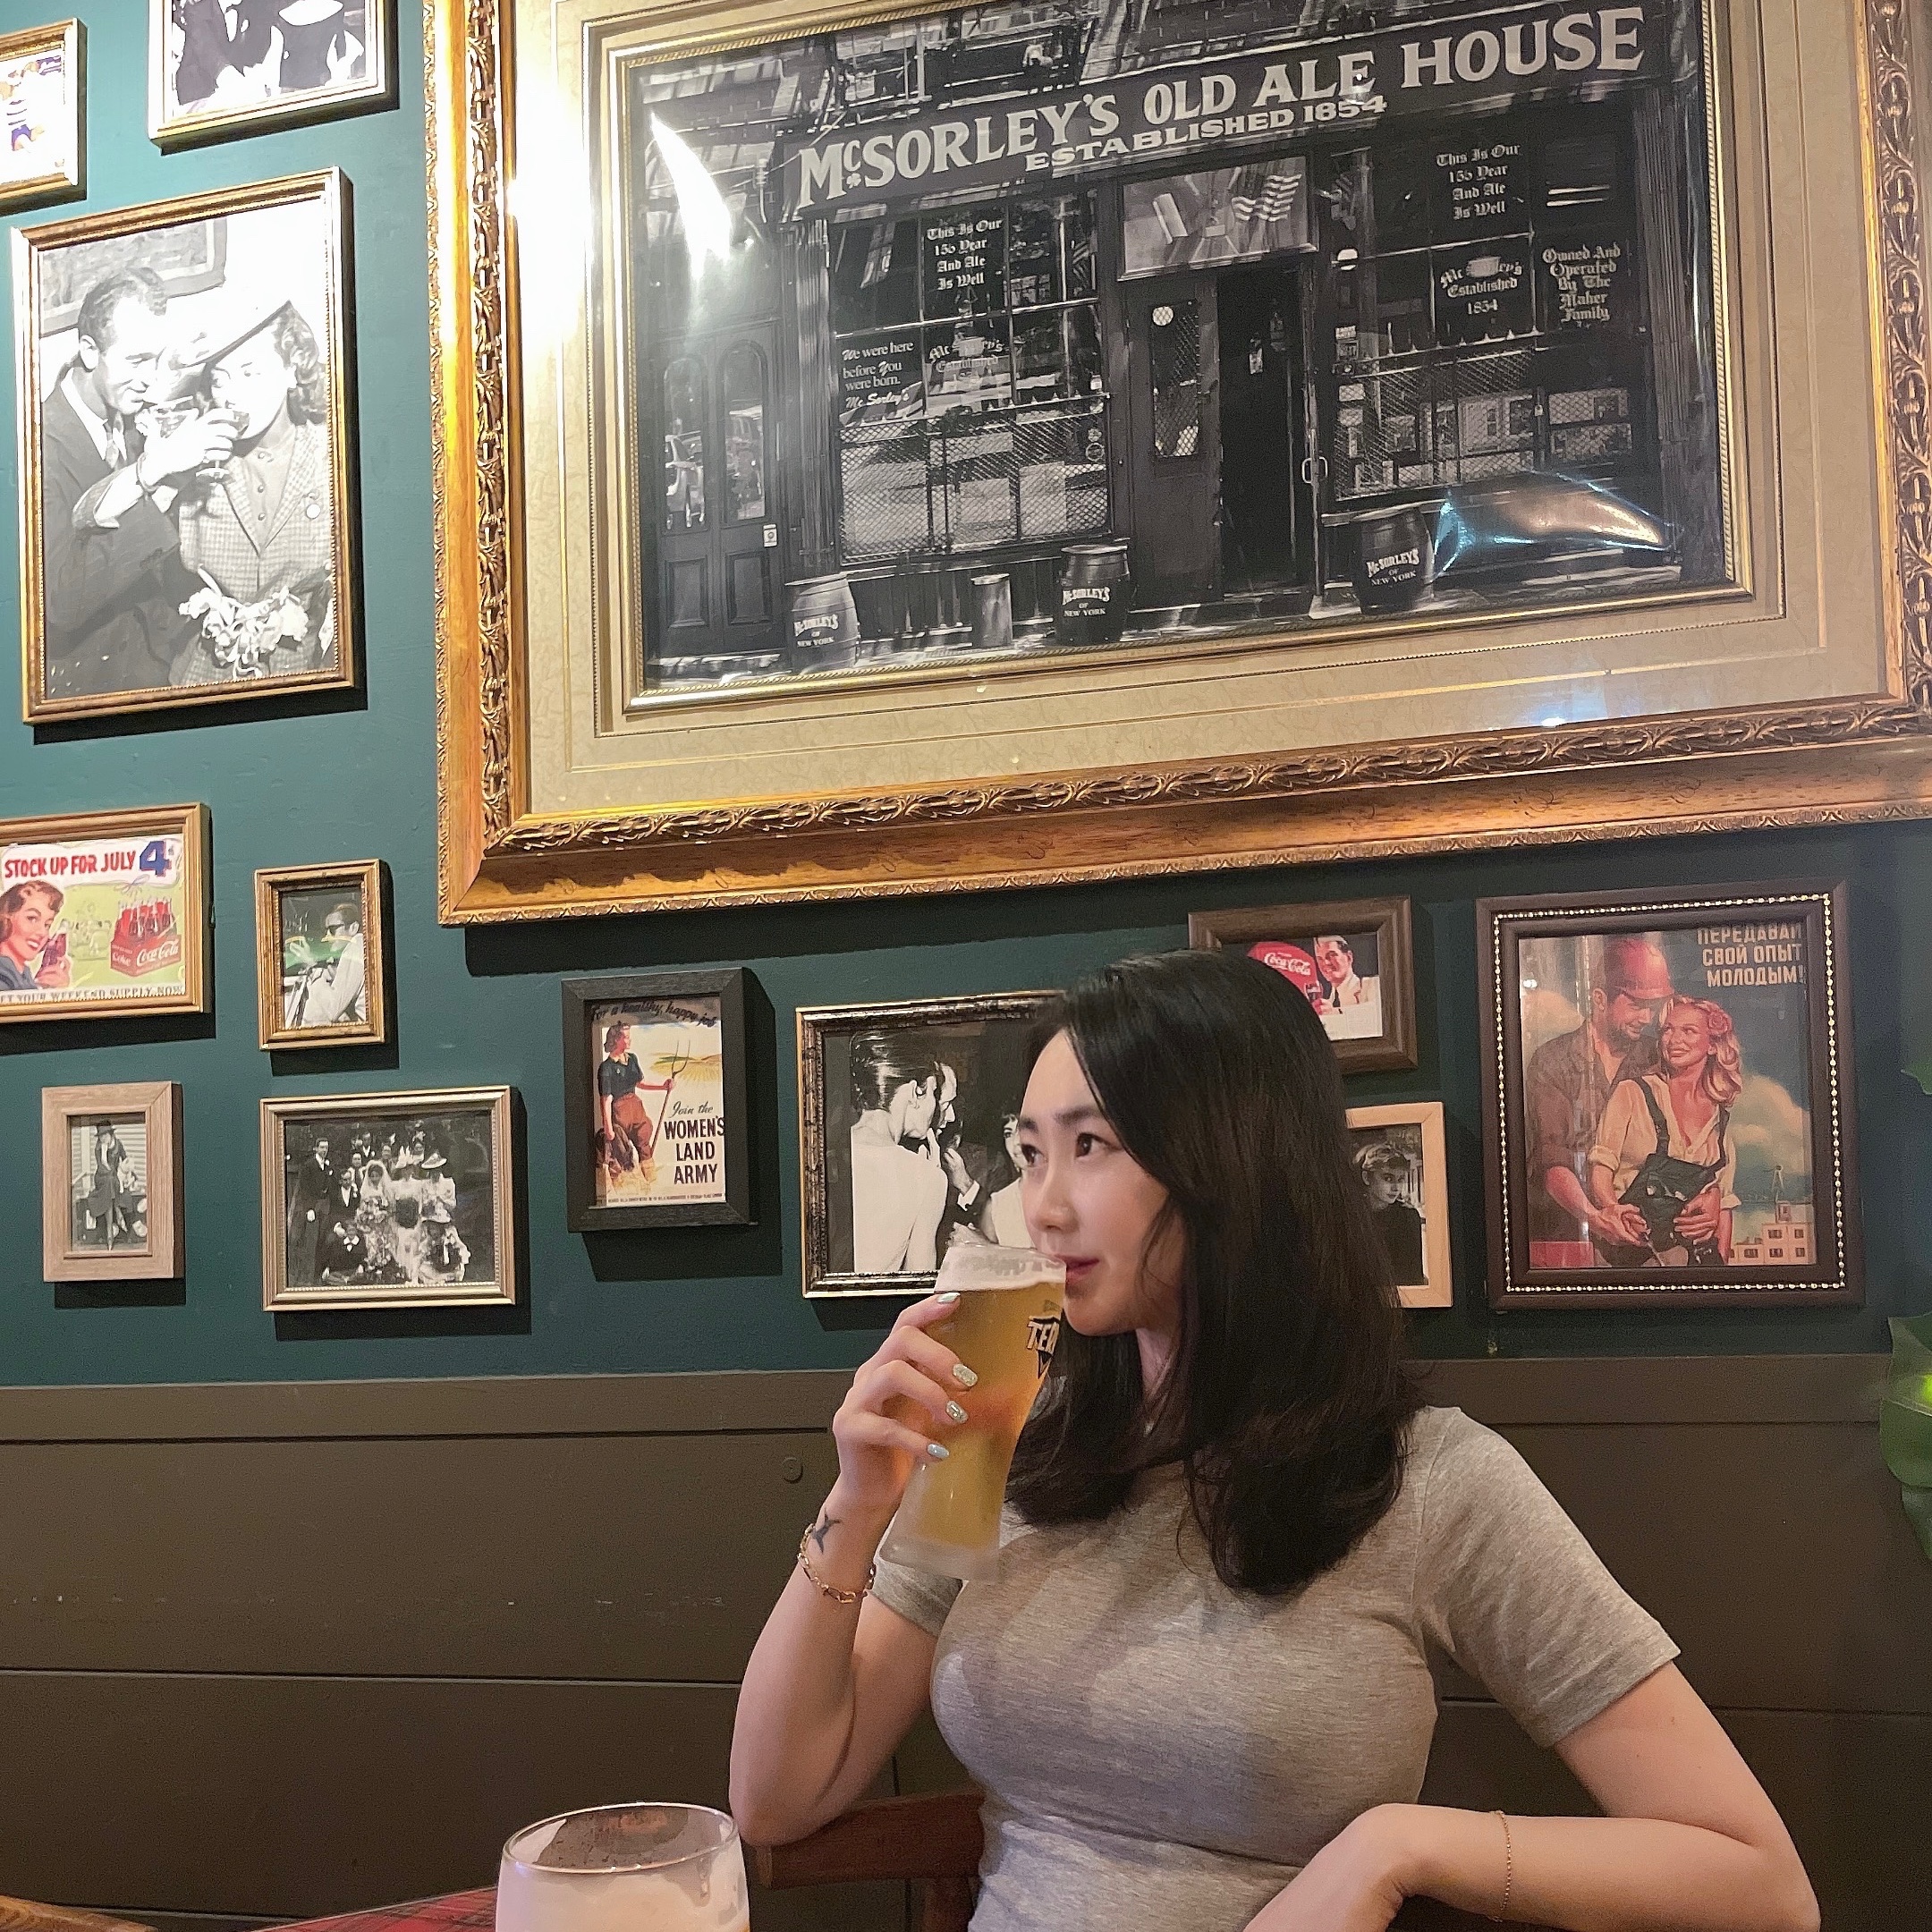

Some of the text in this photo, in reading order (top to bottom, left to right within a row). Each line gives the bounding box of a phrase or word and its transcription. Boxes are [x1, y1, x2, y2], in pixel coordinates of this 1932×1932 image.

[1143, 74, 1236, 125] OLD
[1252, 50, 1376, 107] ALE
[1400, 6, 1645, 89] HOUSE
[1025, 95, 1387, 172] ESTABLISHED 1854
[1436, 144, 1521, 167] This Is Our
[1475, 165, 1509, 181] Year
[1452, 182, 1506, 200] And Ale
[1453, 200, 1506, 220] Is Well
[927, 226, 955, 241] This
[975, 219, 1003, 233] Our
[958, 238, 987, 254] Year
[1542, 242, 1621, 264] Owned And
[936, 255, 987, 273] And Ale
[1549, 259, 1617, 280] Operated
[937, 272, 985, 291] Is Well
[1447, 276, 1519, 298] Established
[1581, 275, 1612, 289] The
[1467, 299, 1498, 315] 1854
[1561, 306, 1610, 323] Family
[842, 342, 914, 361] We were here
[843, 360, 902, 379] before You
[844, 379, 871, 392] were
[1392, 569, 1417, 582] YORK
[1063, 607, 1106, 617] NEW YORK
[4, 858, 47, 878] STOCK
[50, 856, 69, 875] UP
[71, 854, 97, 875] FOR
[100, 850, 136, 872] JULY
[1702, 943, 1802, 967] СВОЙ ОПЫТ
[1707, 964, 1804, 987] МОЛОДЫМ!
[669, 1100, 713, 1118] Join the
[664, 1114, 724, 1140] WOMEN'S
[675, 1140, 716, 1162] LAND
[674, 1163, 718, 1185] ARMY
